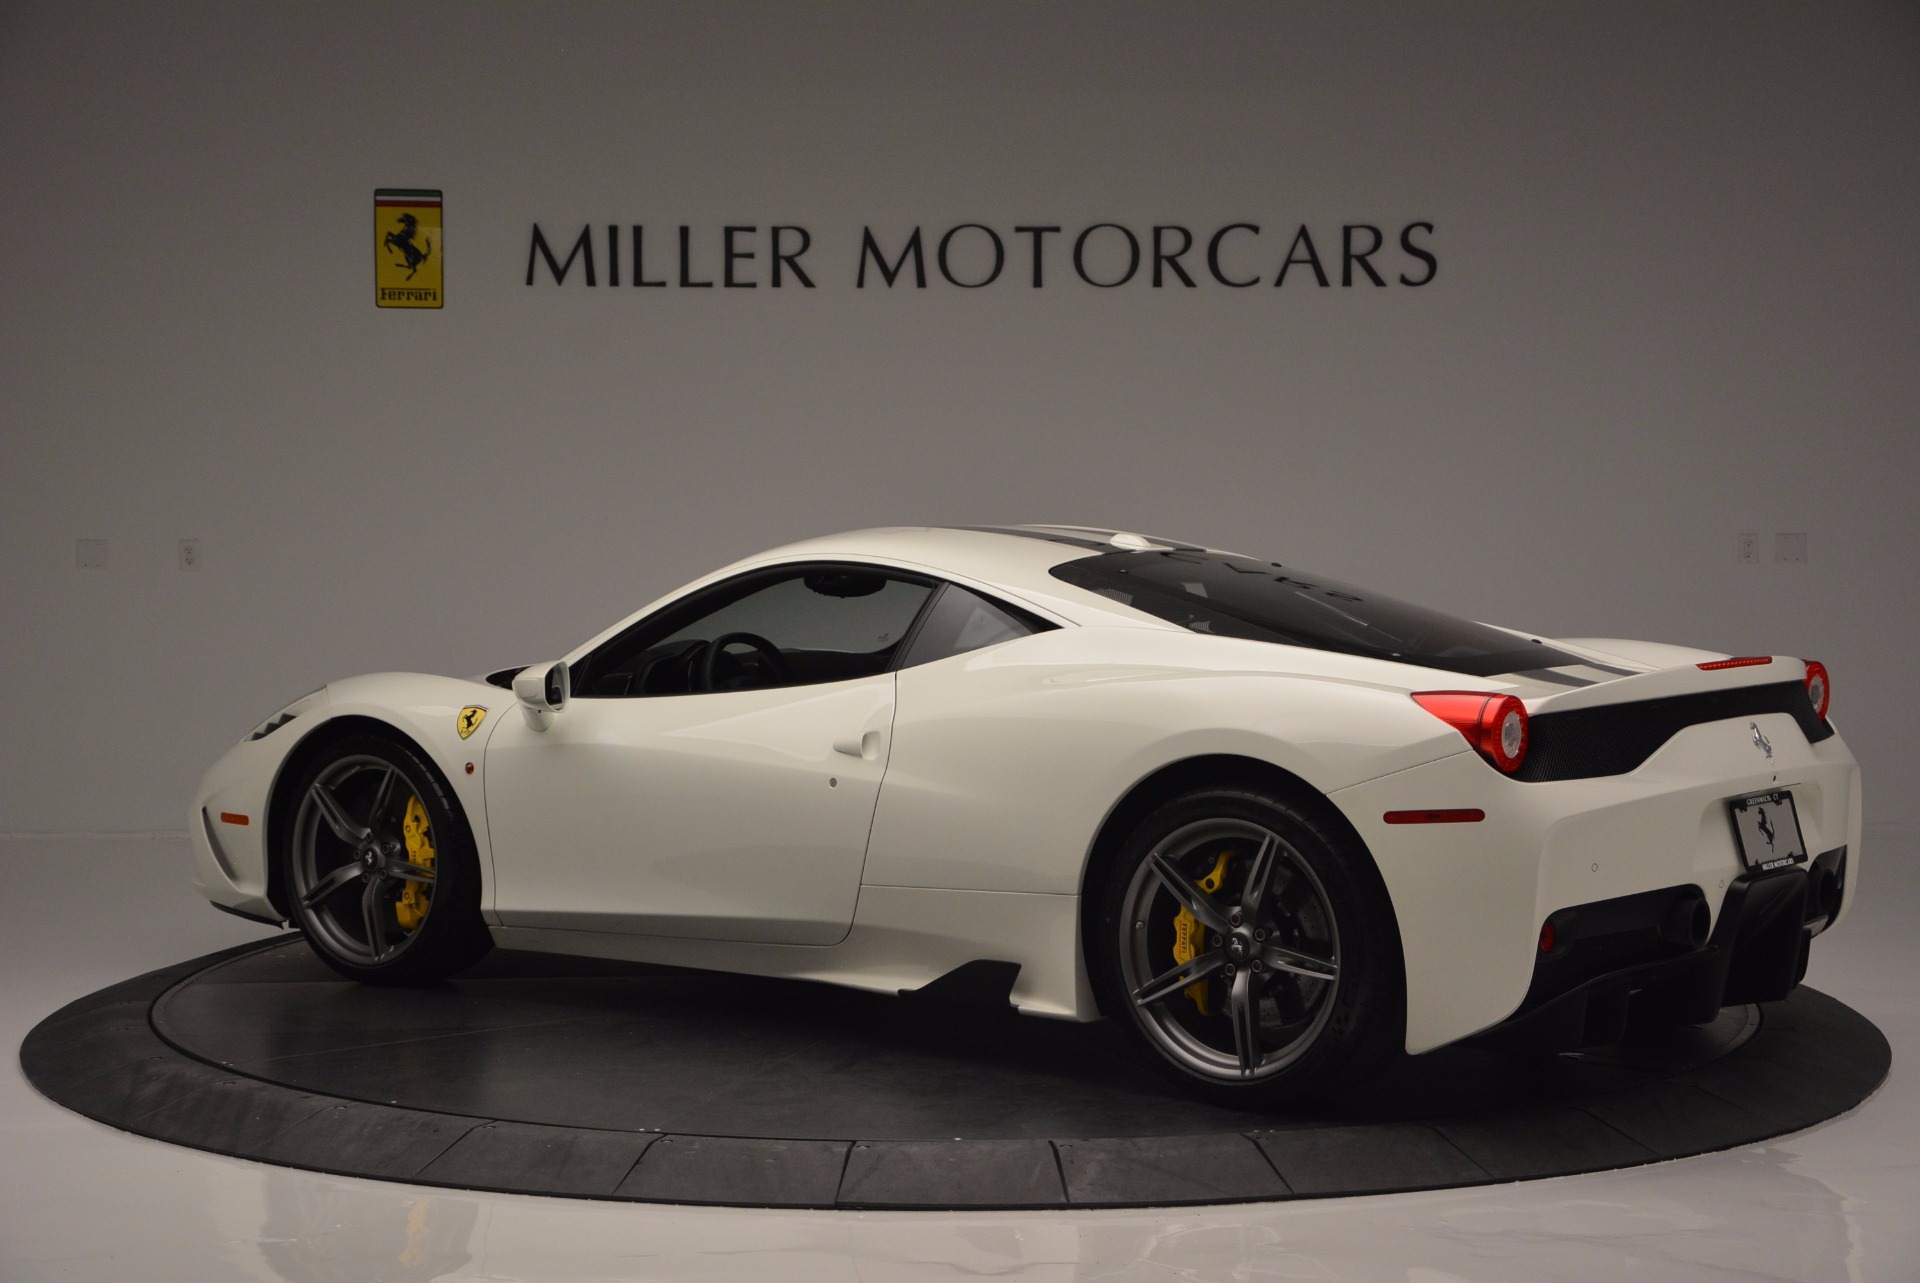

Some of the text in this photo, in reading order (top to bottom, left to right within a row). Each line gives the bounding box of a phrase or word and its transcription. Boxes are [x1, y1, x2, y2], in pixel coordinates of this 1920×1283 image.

[525, 222, 1438, 288] MILLER MOTORCARS
[380, 288, 437, 301] Ferrari
